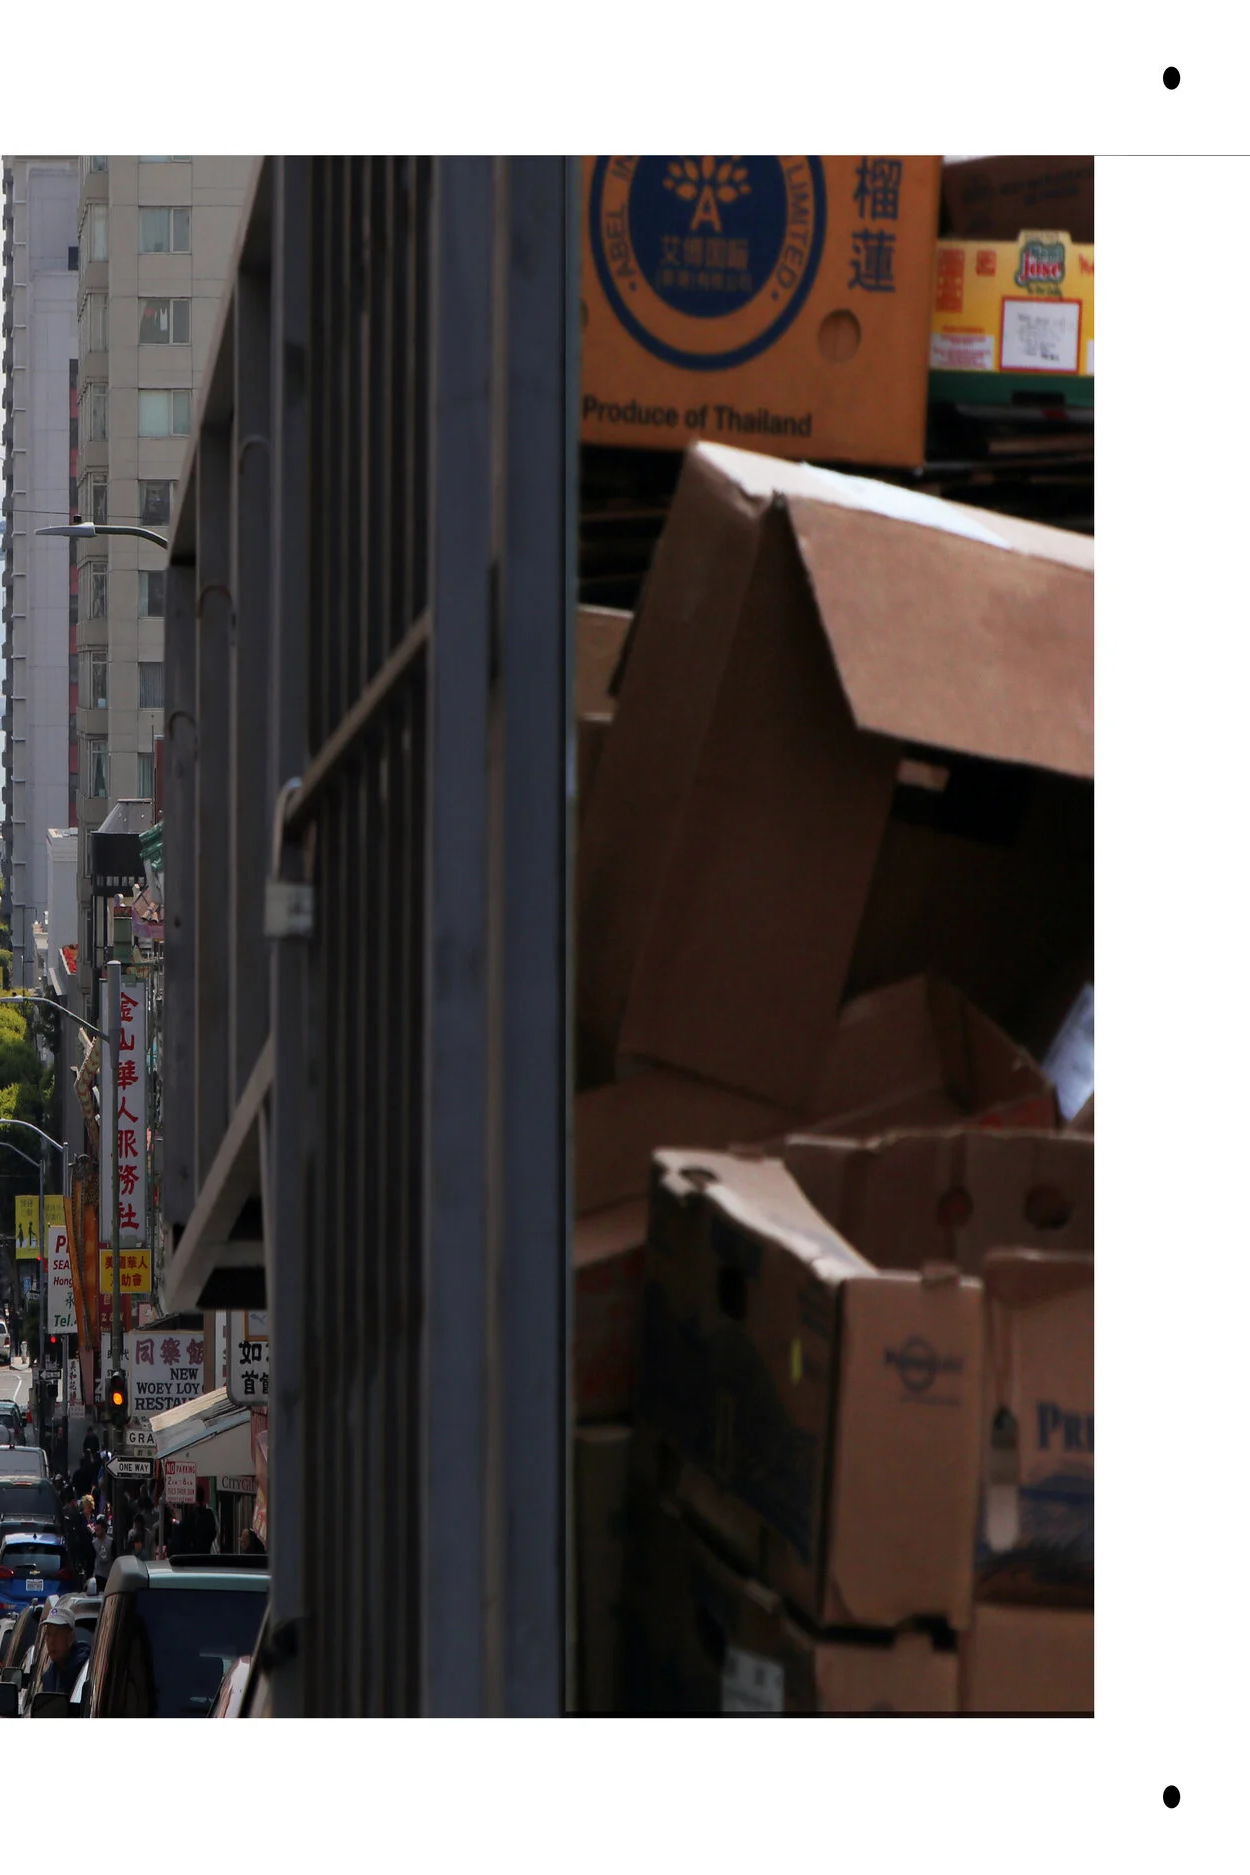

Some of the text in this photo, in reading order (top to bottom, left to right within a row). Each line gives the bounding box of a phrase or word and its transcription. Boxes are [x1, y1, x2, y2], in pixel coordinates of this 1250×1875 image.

[776, 164, 810, 289] LIMITED
[606, 204, 636, 278] ABEL
[581, 395, 813, 437] Produce of Thailand
[170, 1368, 198, 1380] NEW
[136, 1382, 200, 1394] WOEY LOY
[129, 1432, 155, 1444] GRA
[119, 1462, 149, 1472] ONE WAY
[166, 1462, 196, 1475] NO PARKING
